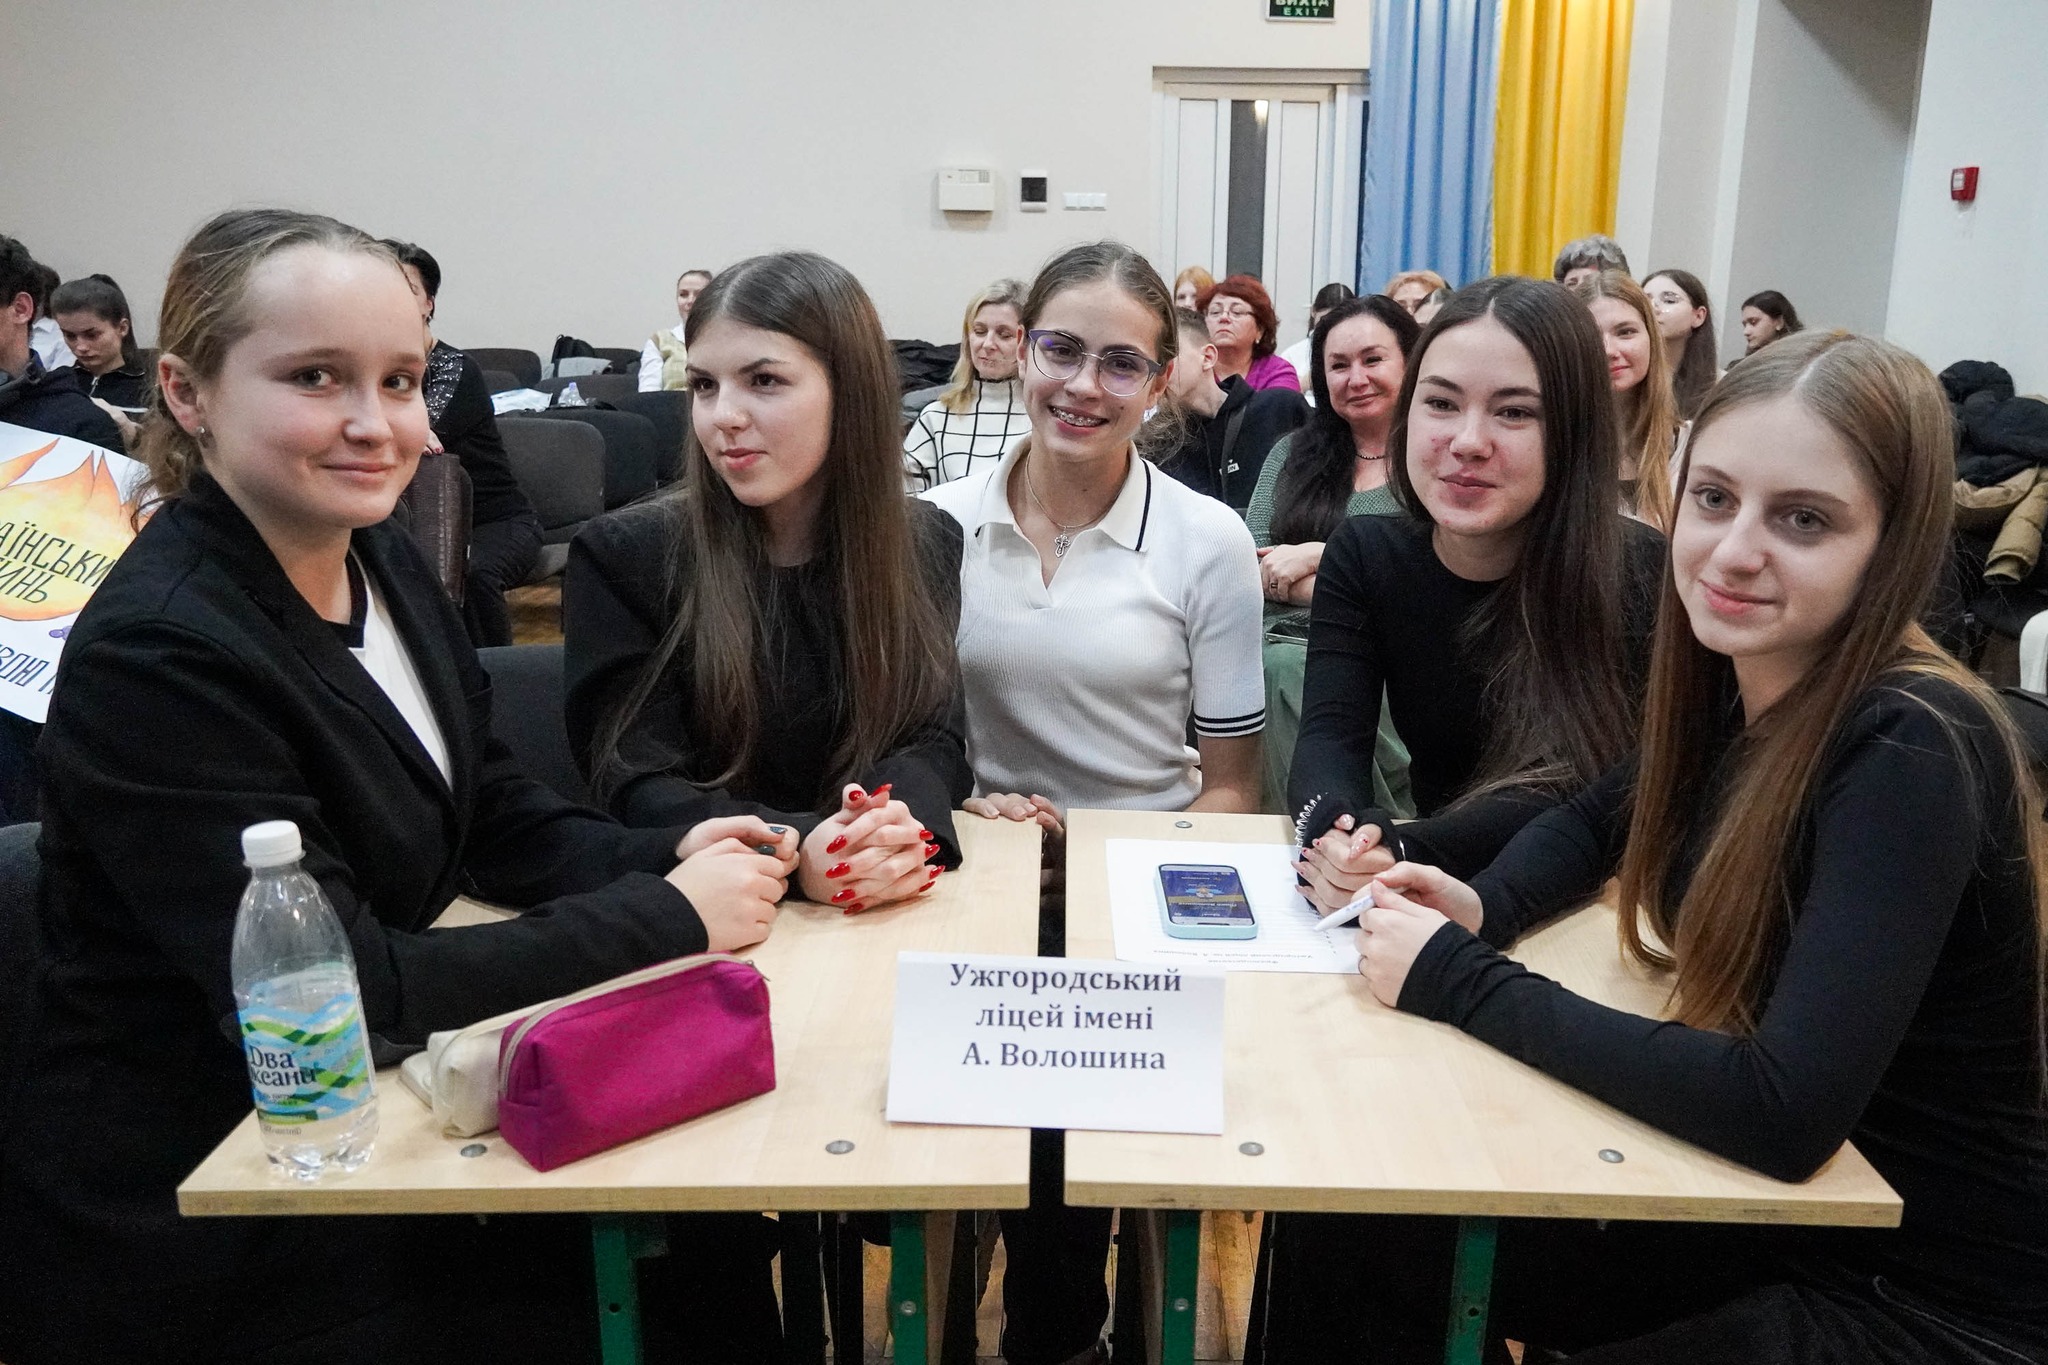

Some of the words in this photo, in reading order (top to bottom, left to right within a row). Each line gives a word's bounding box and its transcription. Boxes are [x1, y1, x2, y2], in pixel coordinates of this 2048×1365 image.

[1283, 7, 1319, 16] EXIT
[951, 963, 1182, 995] Ужгородський
[976, 1003, 1064, 1031] ліцей
[1074, 1006, 1153, 1030] імені
[962, 1042, 990, 1066] А.
[1001, 1043, 1166, 1070] Волошина
